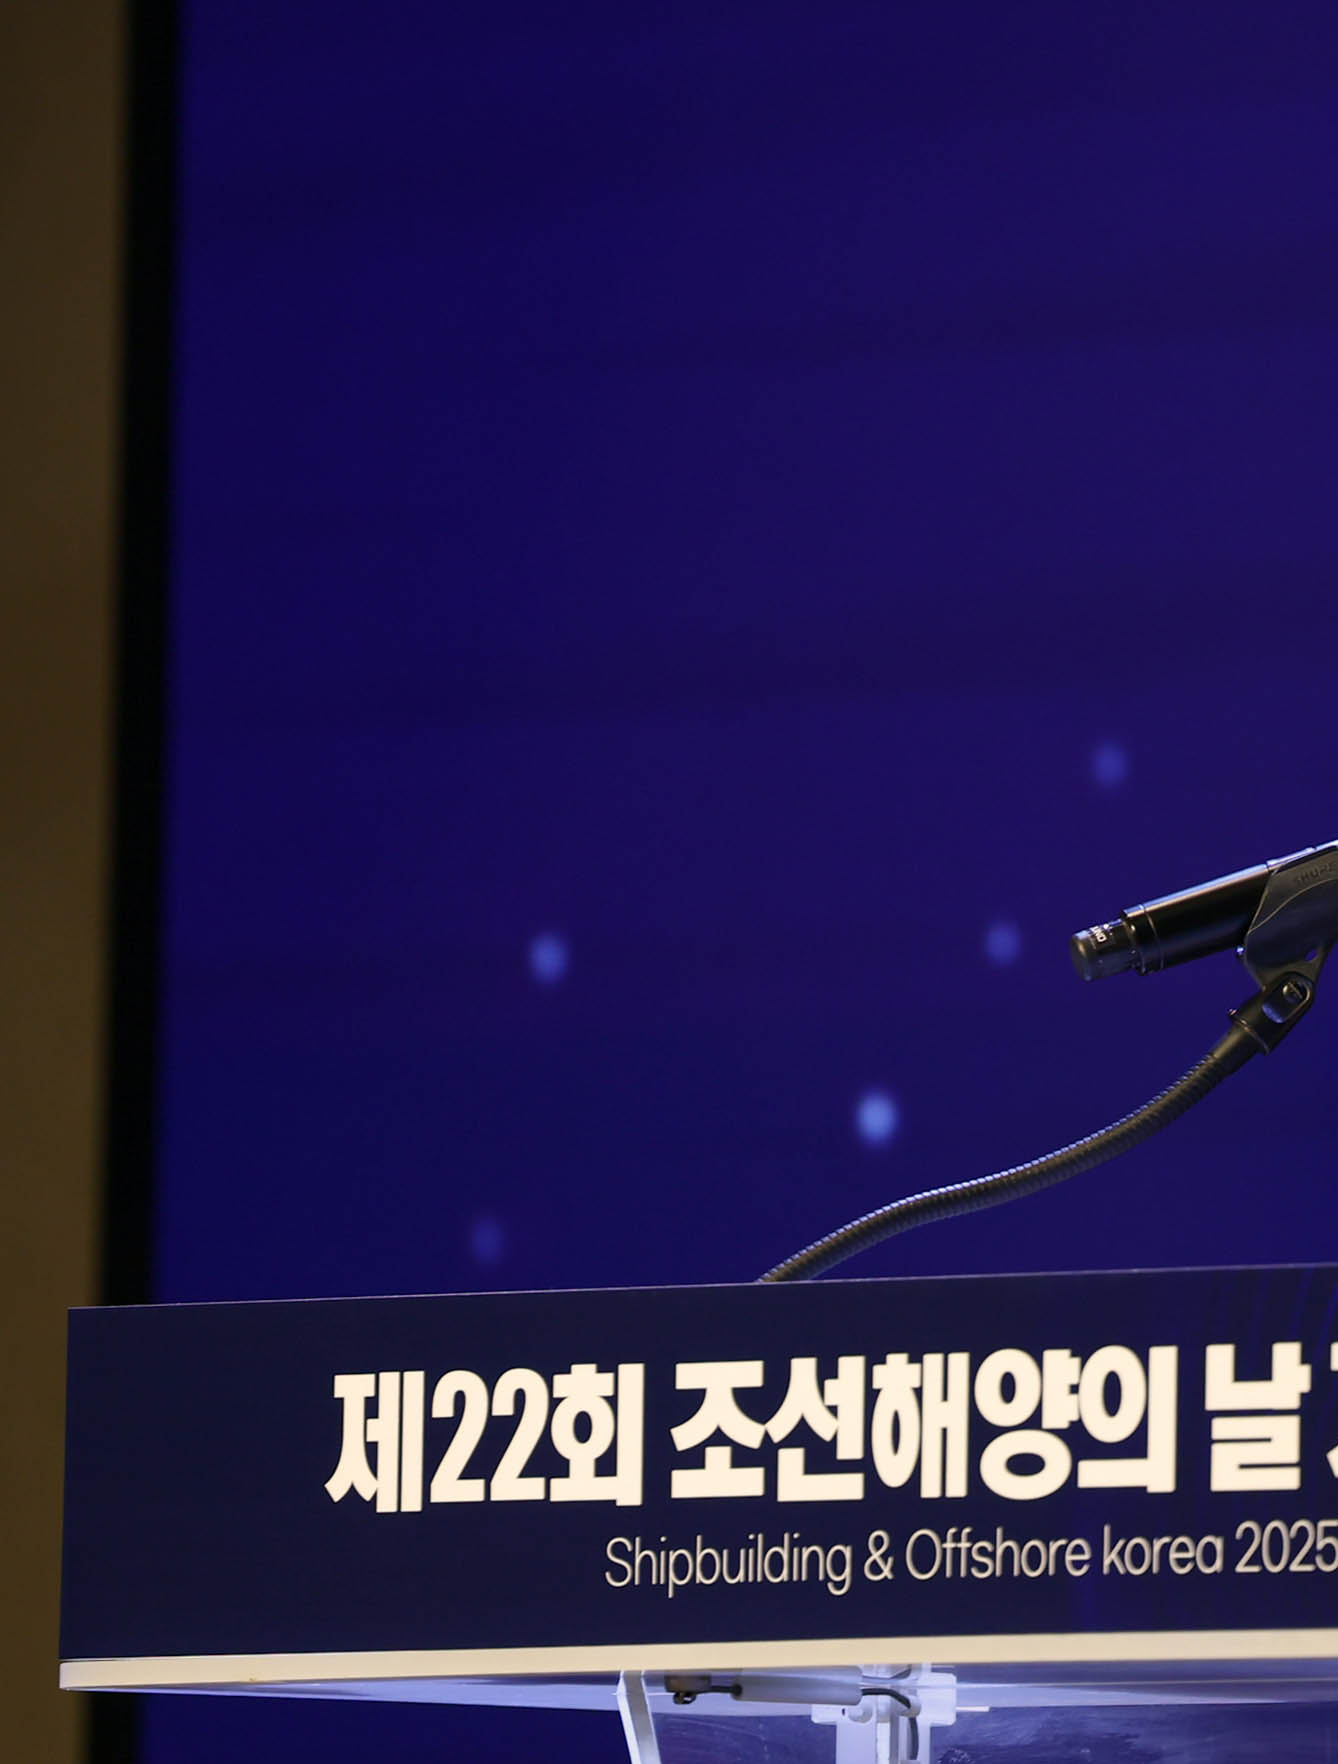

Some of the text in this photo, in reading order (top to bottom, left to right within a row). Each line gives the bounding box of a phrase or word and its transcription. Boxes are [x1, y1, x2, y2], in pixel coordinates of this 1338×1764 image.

[325, 1363, 644, 1513] 제22회
[670, 1345, 1178, 1502] 조선해양의
[1205, 1342, 1311, 1492] 날
[605, 1532, 852, 1599] Shipbuilding
[863, 1529, 895, 1582] &
[905, 1526, 1092, 1580] Offshore
[1102, 1524, 1224, 1576] korea
